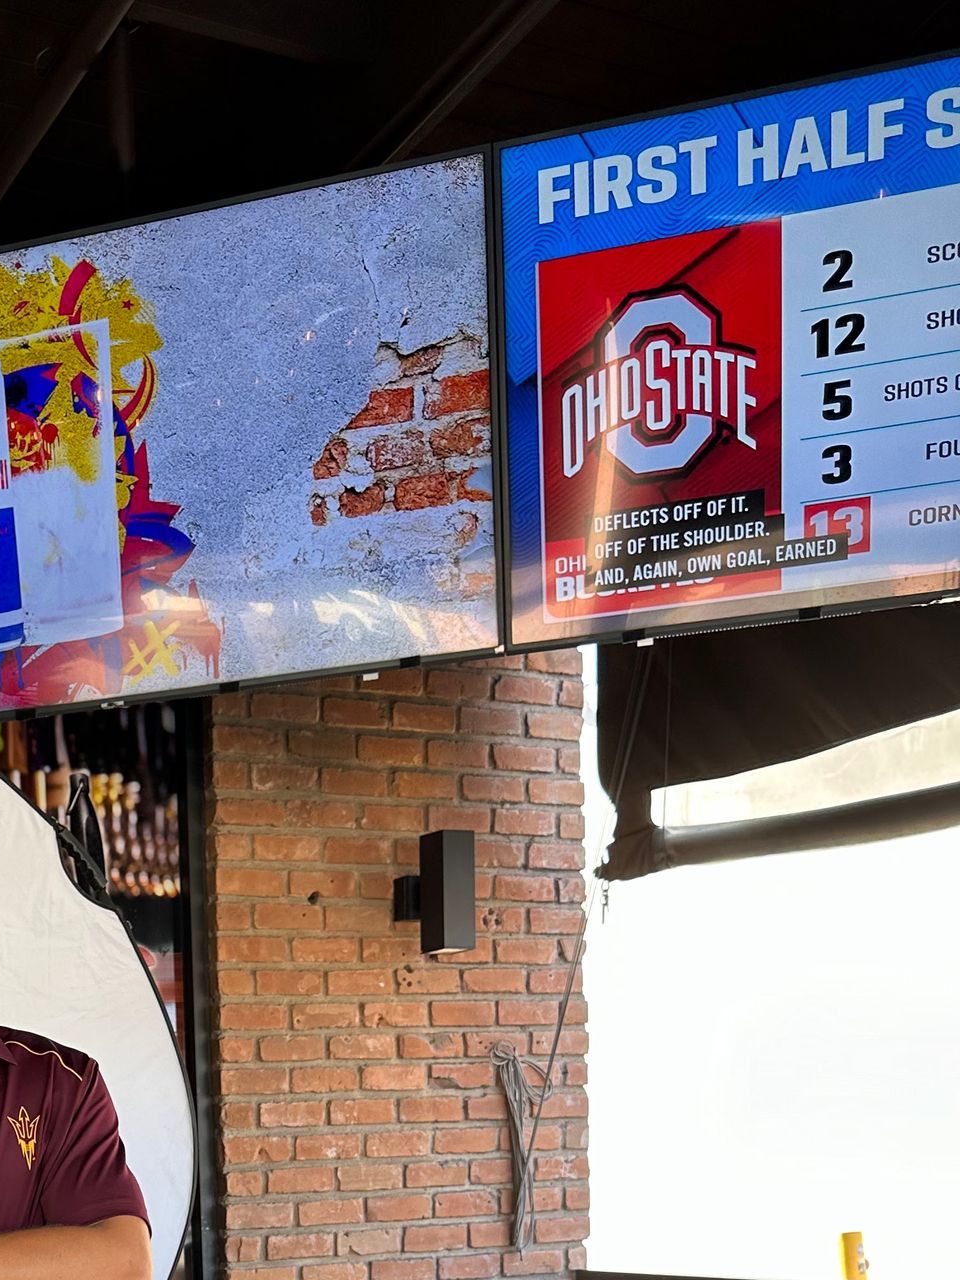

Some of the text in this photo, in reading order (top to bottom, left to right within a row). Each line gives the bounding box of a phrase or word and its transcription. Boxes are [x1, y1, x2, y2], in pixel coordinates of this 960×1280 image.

[537, 135, 718, 225] FIRST
[737, 98, 905, 188] HALF
[821, 249, 853, 293] 2
[926, 241, 960, 264] SC
[809, 313, 866, 359] 12
[561, 339, 757, 479] OHIO STATE
[821, 378, 853, 422] 5
[883, 375, 949, 402] SHOTS
[821, 443, 853, 485] 3
[593, 495, 749, 533] DEFLECTS OFF OF IT.
[808, 505, 865, 547] 13
[593, 521, 770, 561] OFF OF THE SHOULDER.
[594, 538, 838, 588] AND, AGAIN, OWN GOAL, EARNED
